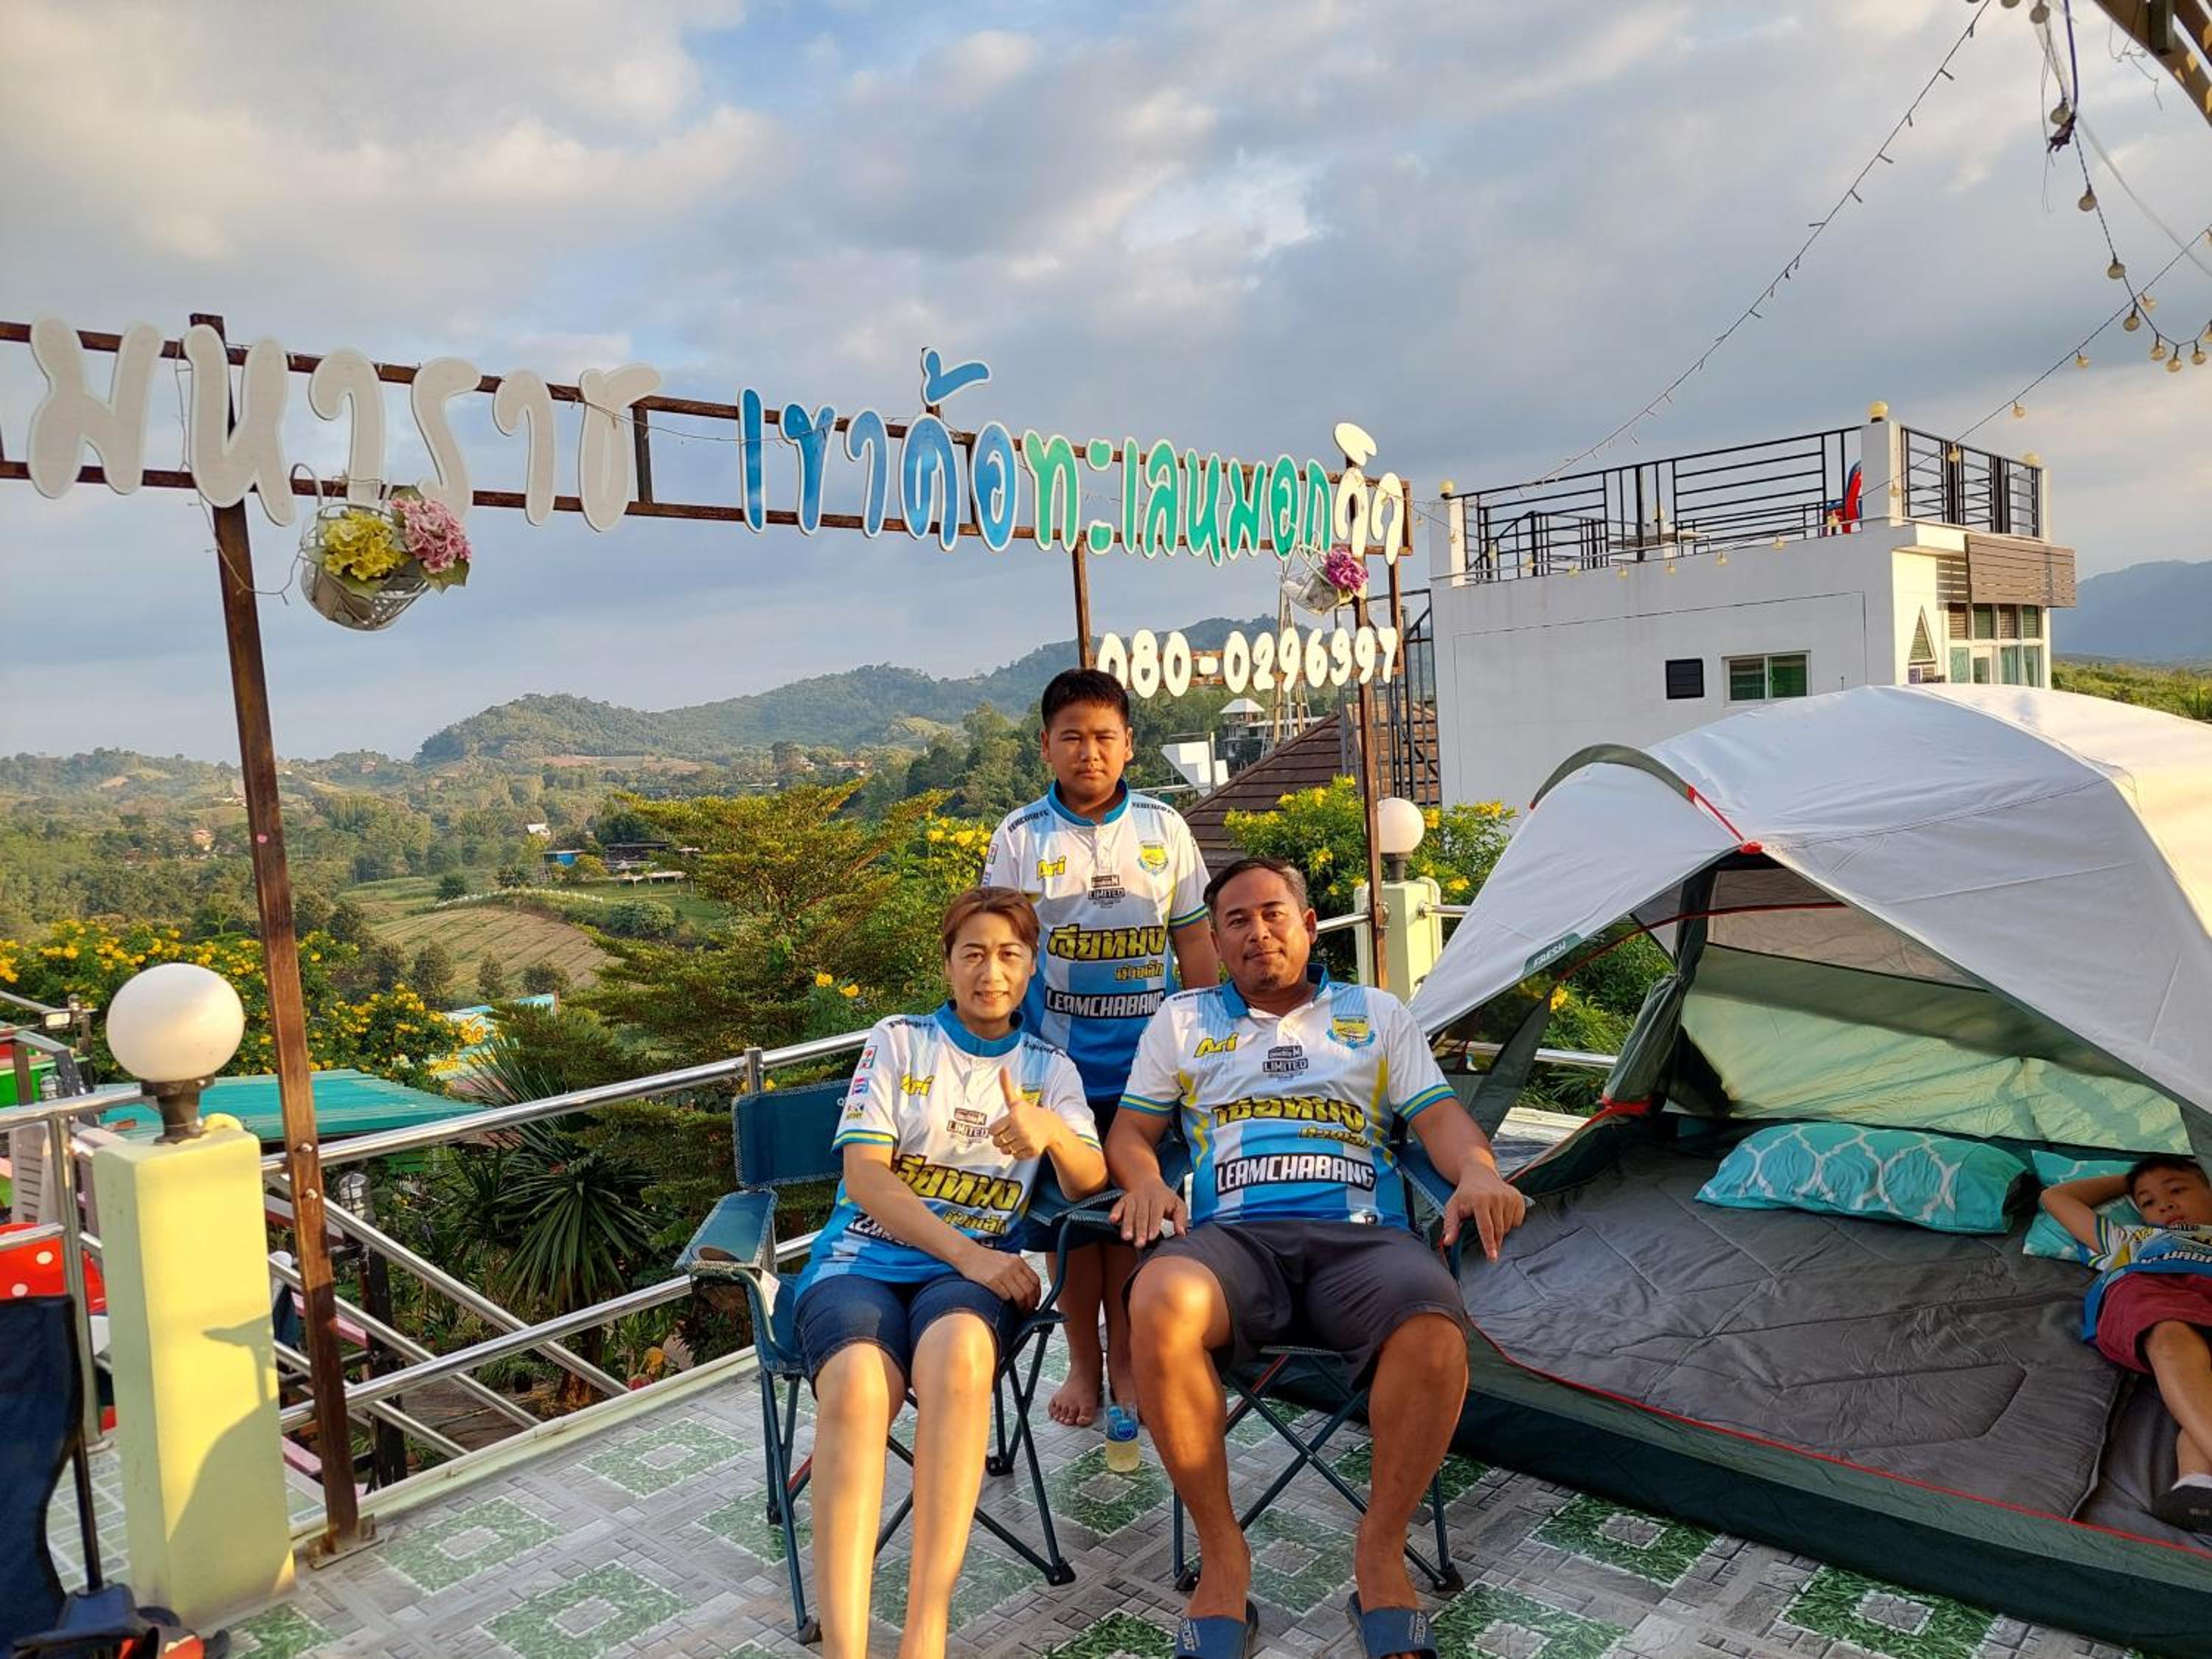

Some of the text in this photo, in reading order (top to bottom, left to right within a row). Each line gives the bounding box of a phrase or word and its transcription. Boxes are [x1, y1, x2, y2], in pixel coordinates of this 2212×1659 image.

[1037, 855, 1066, 880] Ari
[1088, 887, 1126, 900] LIMITED
[1194, 1032, 1239, 1058] Ari
[1263, 1058, 1309, 1072] LIMITED
[1216, 1155, 1377, 1194] LEAMCHABANG
